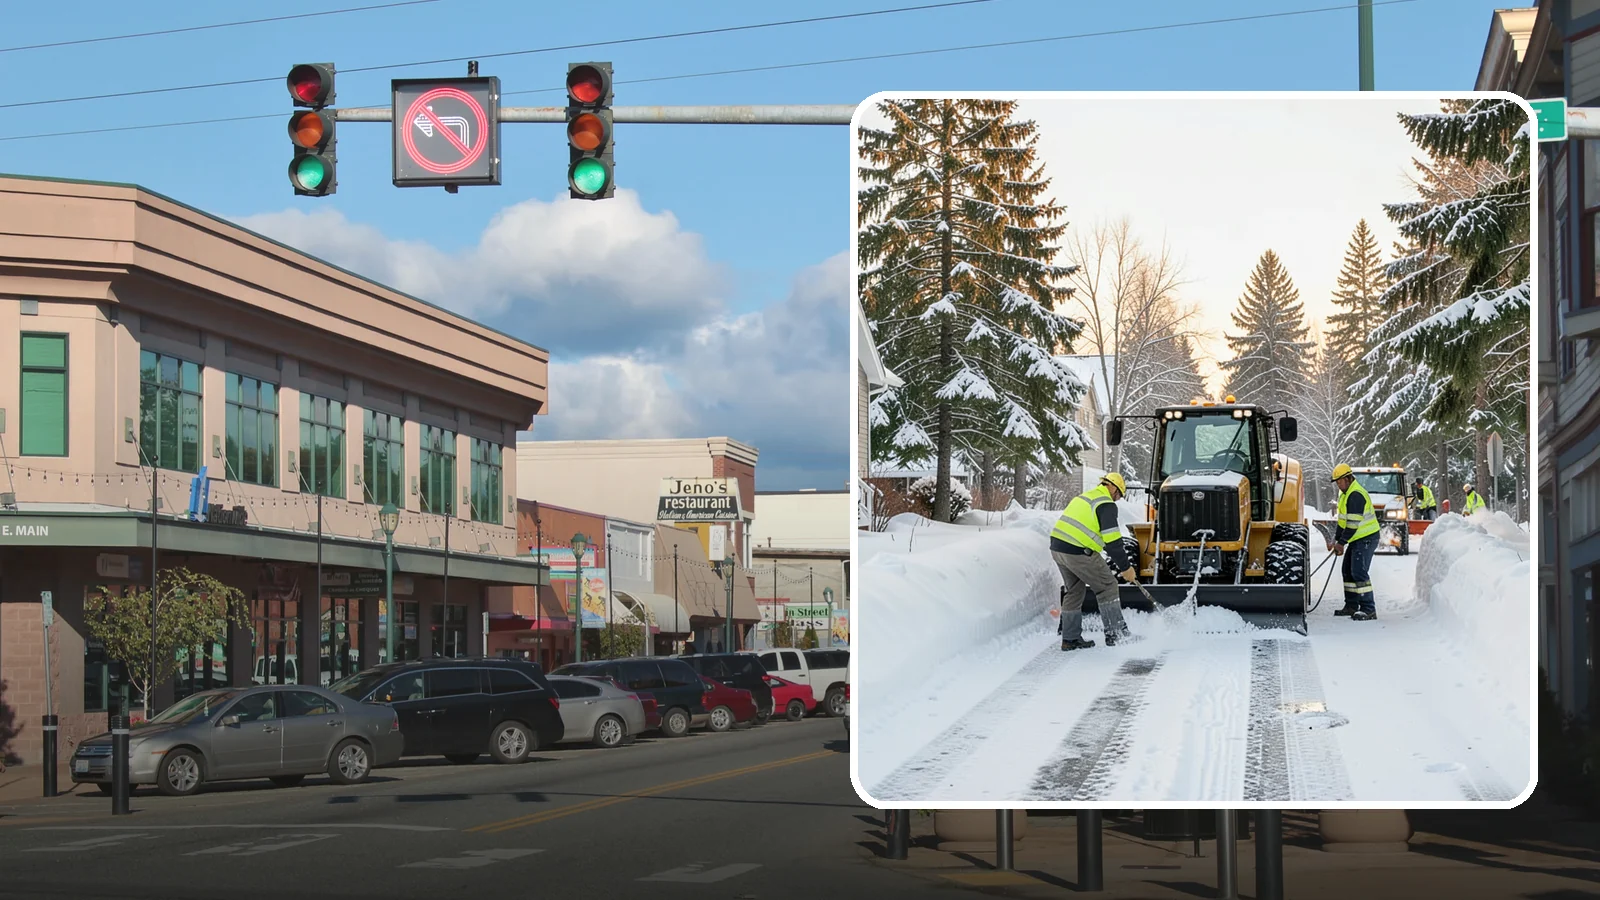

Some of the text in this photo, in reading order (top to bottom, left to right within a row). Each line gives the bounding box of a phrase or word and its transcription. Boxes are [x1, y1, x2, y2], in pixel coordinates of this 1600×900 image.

[670, 480, 727, 494] Jeno's
[665, 497, 731, 508] restaurant
[686, 510, 714, 519] American
[715, 509, 737, 519] Cuisine
[2, 525, 49, 536] E. MAIN
[785, 607, 795, 616] in
[797, 607, 828, 616] Street
[789, 619, 823, 627] lass
